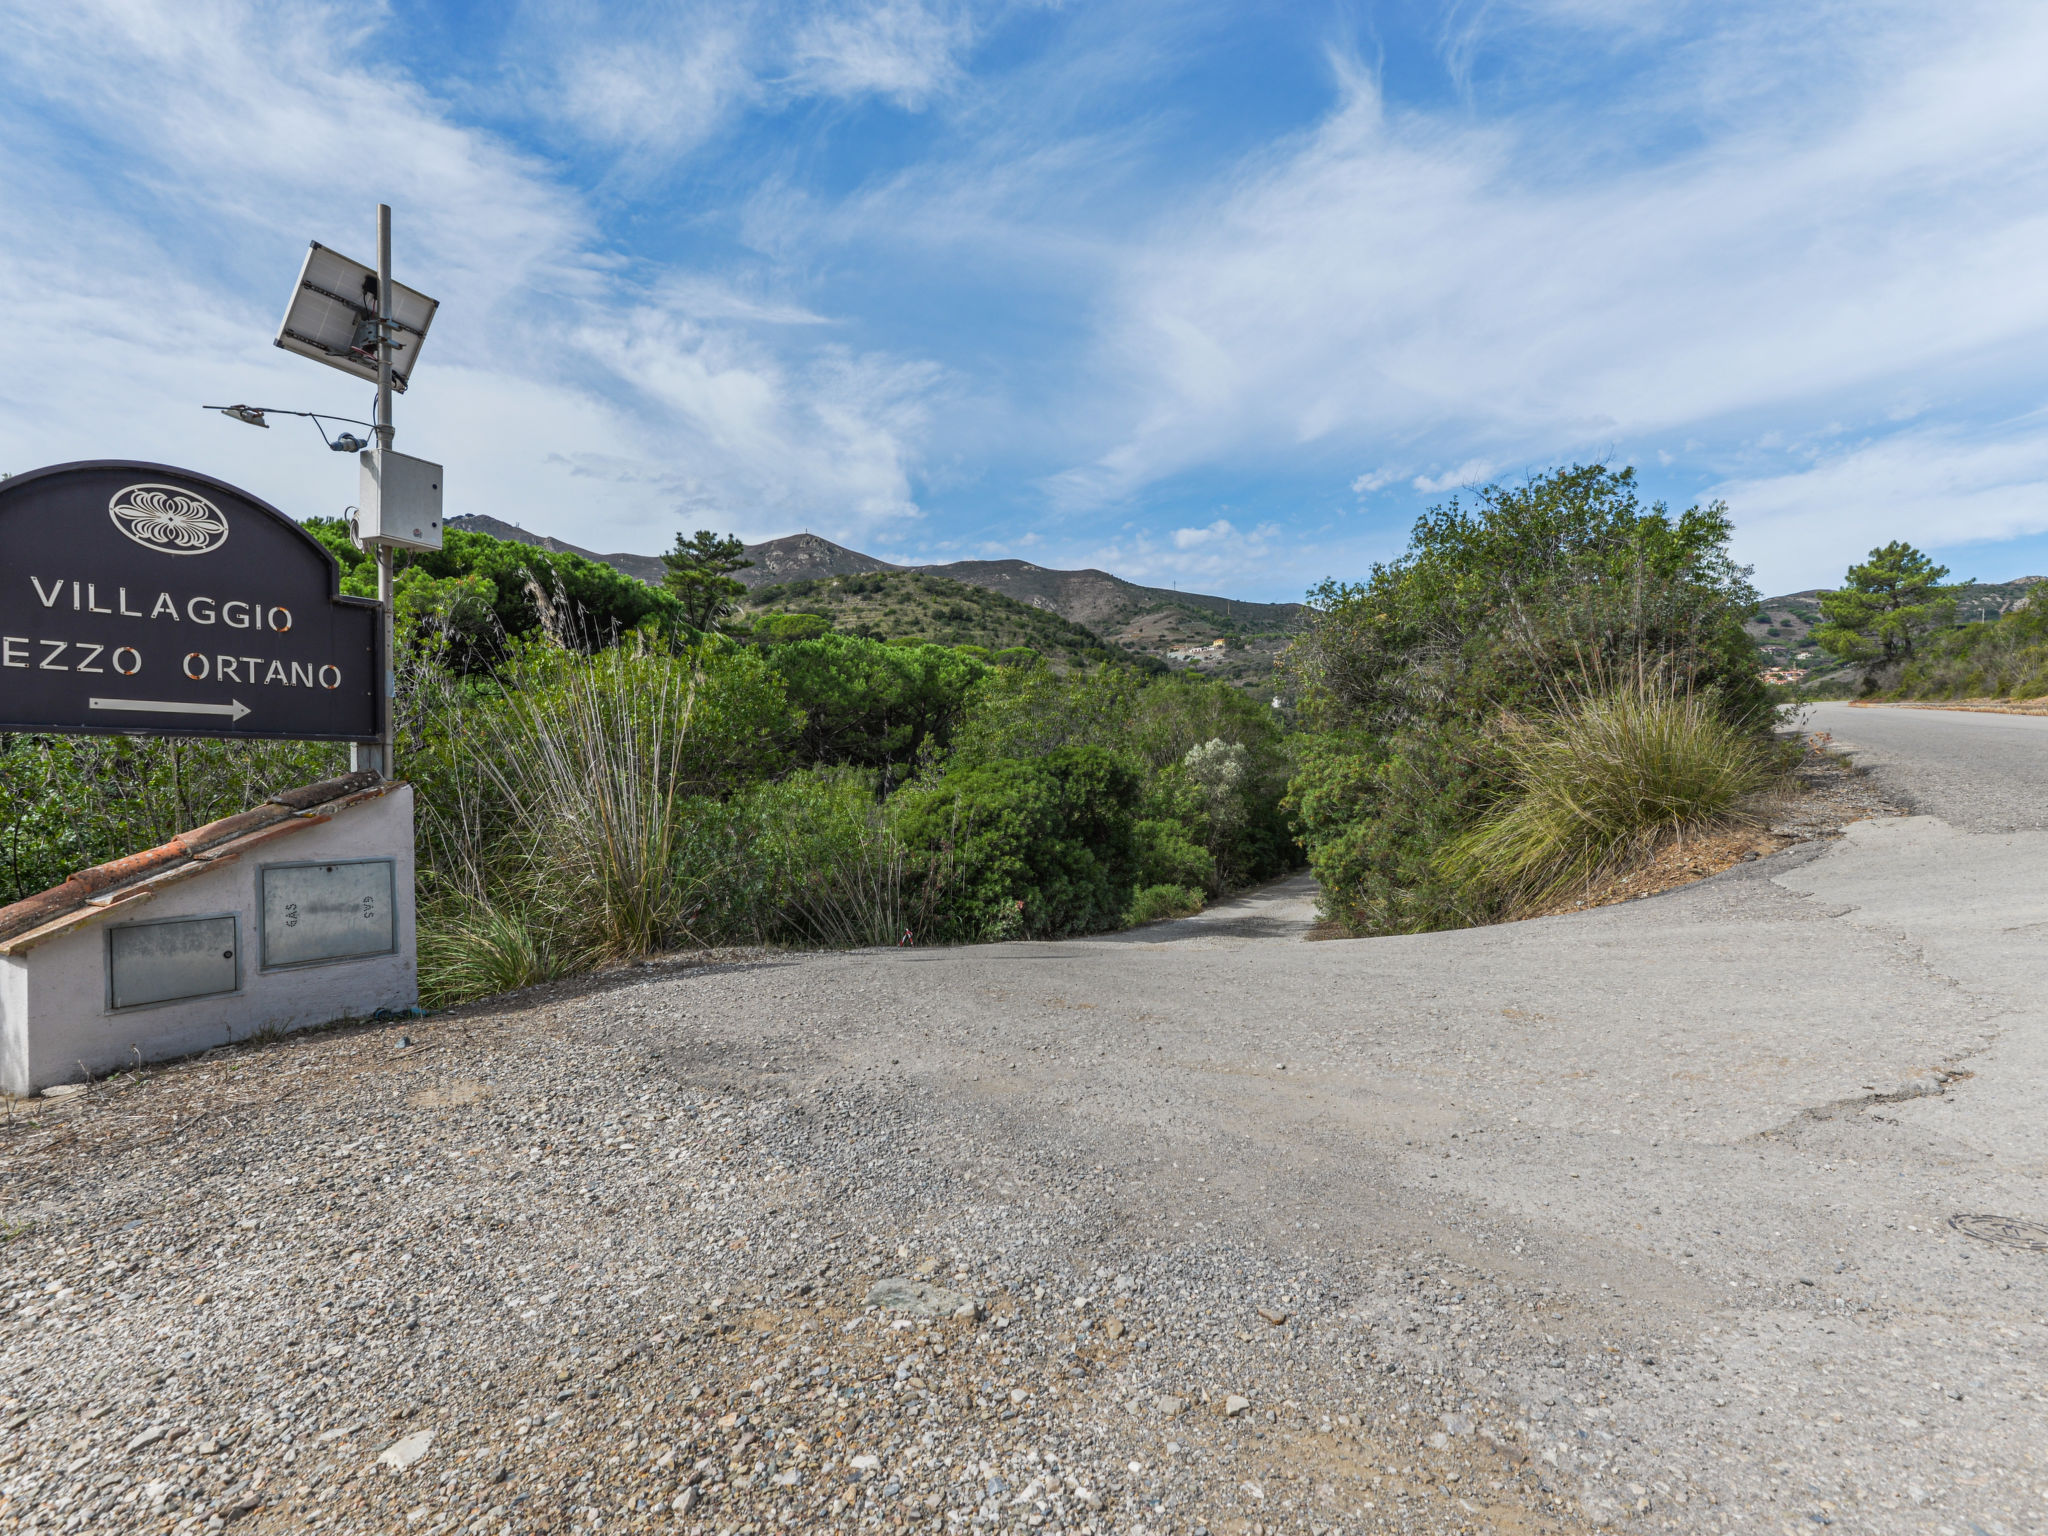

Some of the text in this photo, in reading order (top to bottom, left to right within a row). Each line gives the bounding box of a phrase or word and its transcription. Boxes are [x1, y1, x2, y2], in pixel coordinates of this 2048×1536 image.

[31, 576, 293, 632] VILLAGGIO
[182, 652, 342, 690] ORTANO
[285, 903, 298, 928] GAS
[363, 895, 374, 919] GAS
